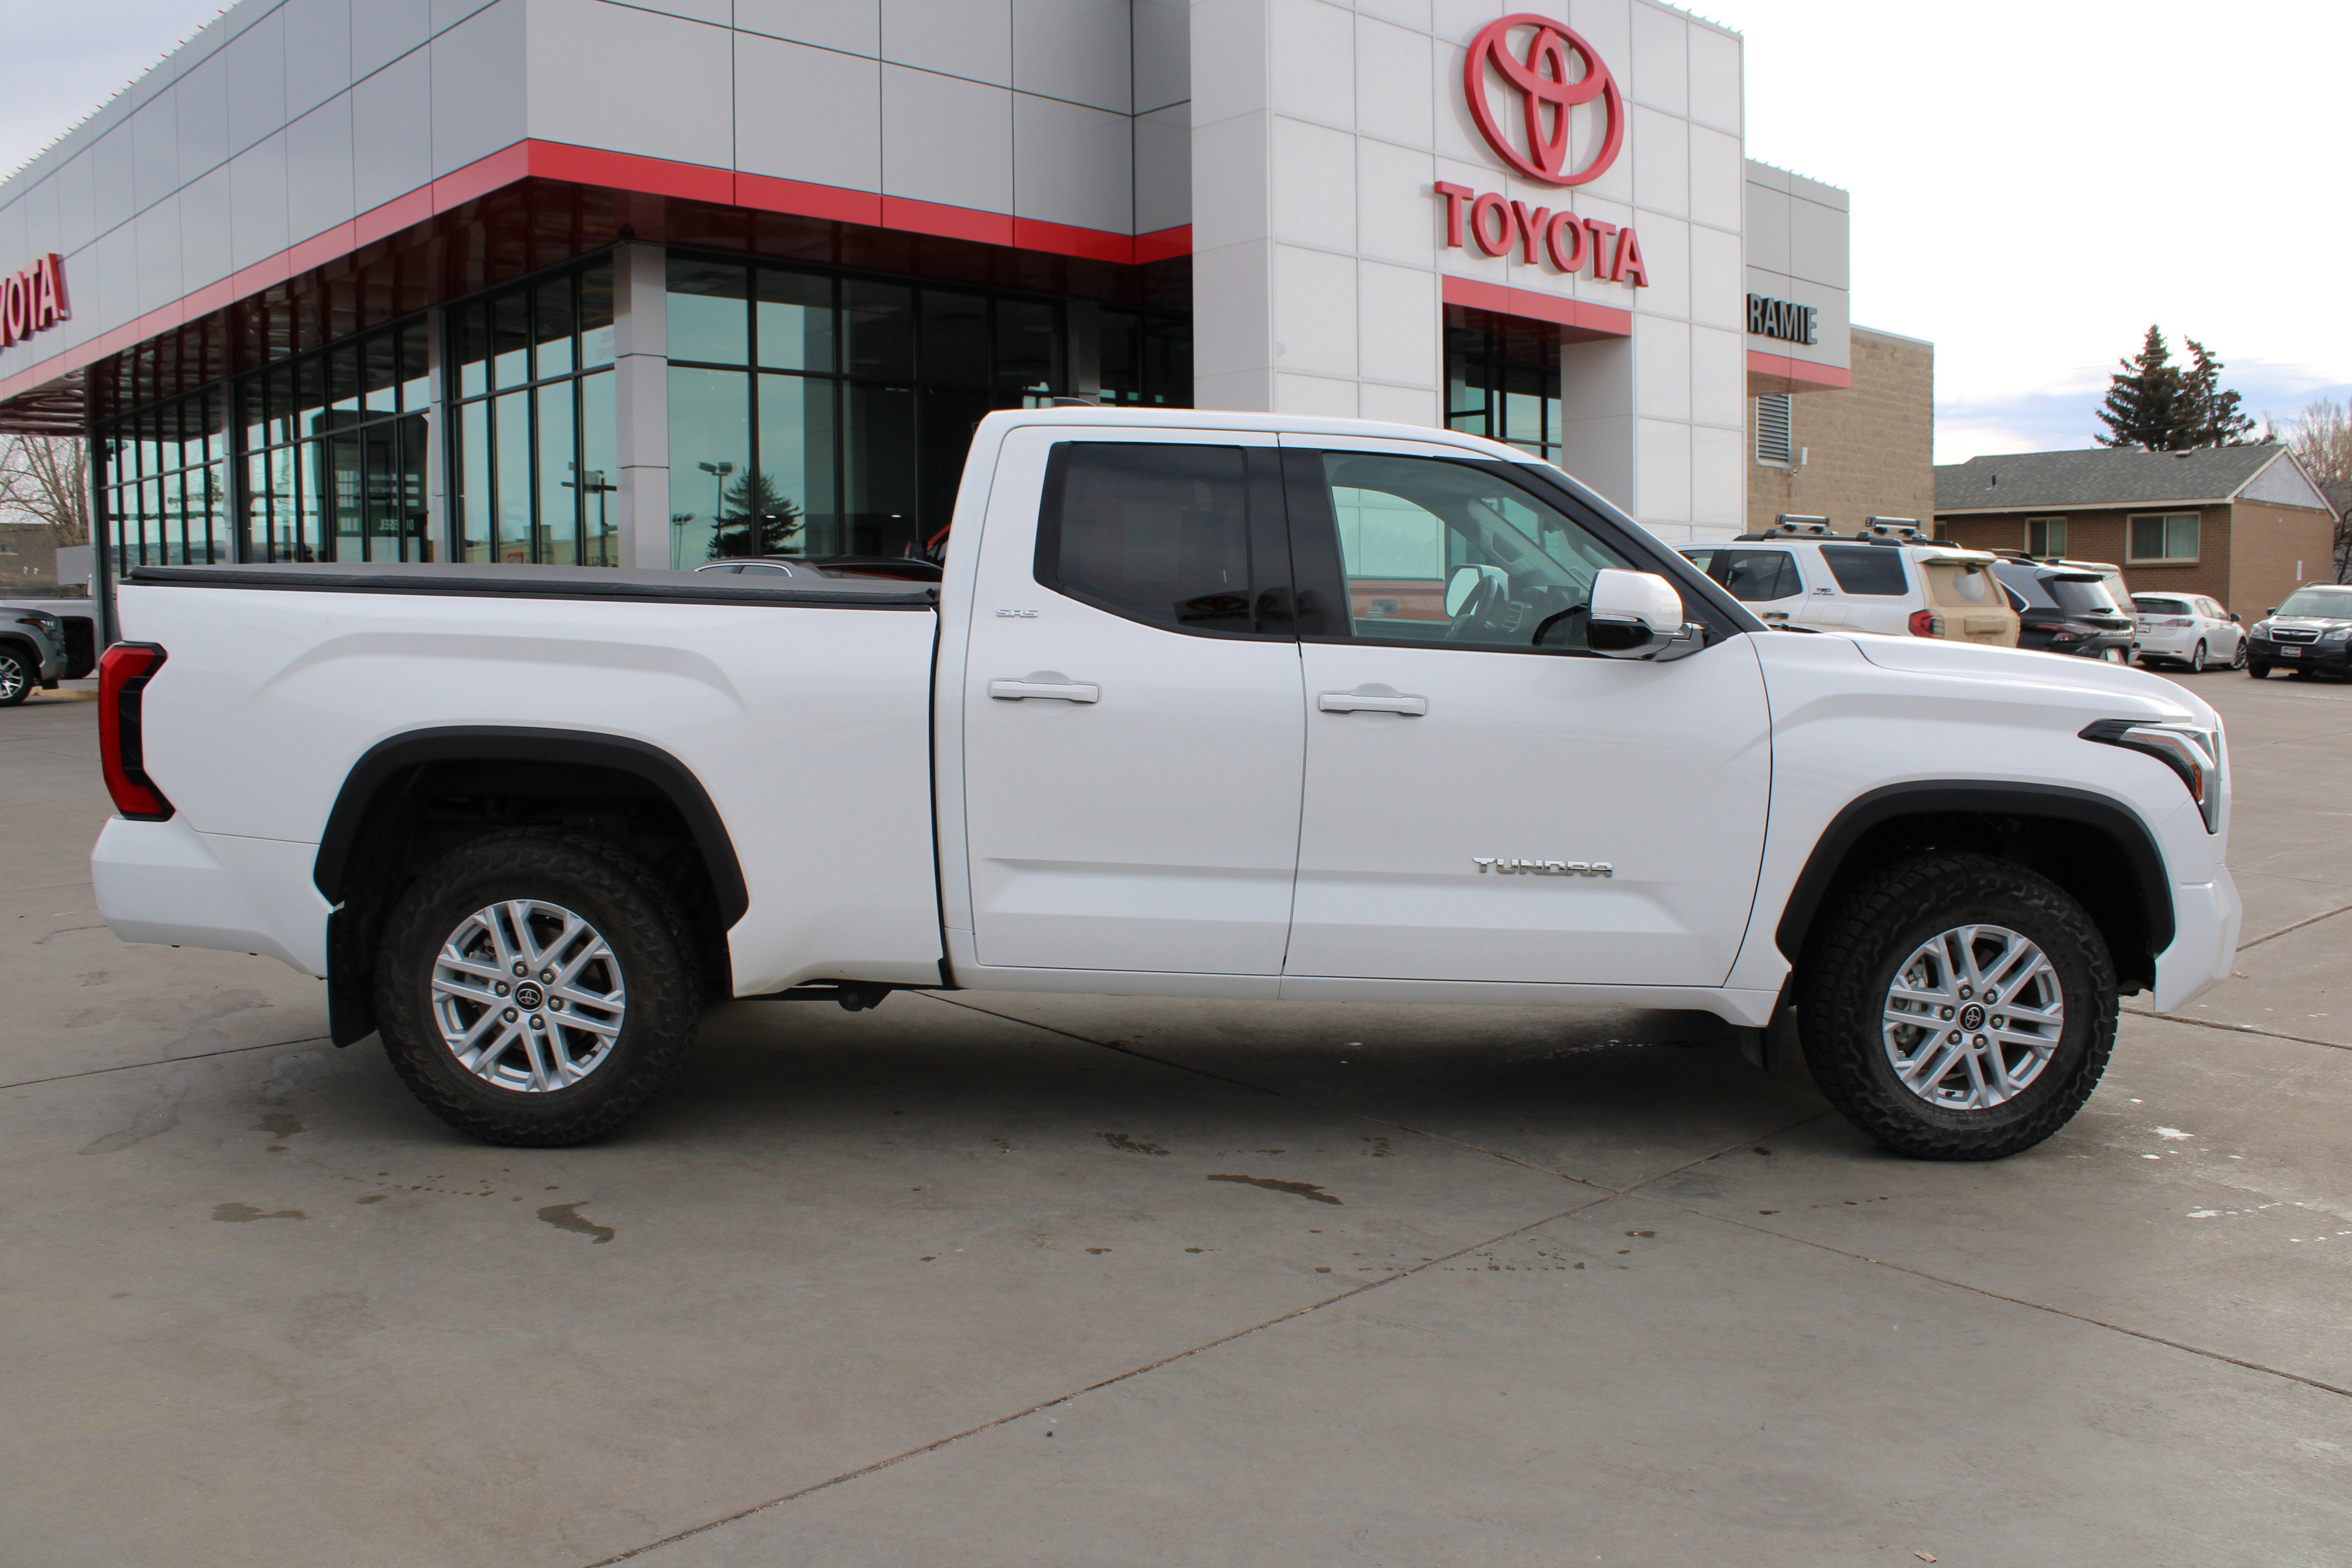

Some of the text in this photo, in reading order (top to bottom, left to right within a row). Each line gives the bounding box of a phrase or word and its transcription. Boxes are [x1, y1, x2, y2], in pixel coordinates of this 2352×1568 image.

[1435, 181, 1648, 287] TOYOTA
[1747, 293, 1817, 344] RAMIE
[996, 609, 1038, 618] SR5
[1472, 858, 1612, 877] TUNDRA
